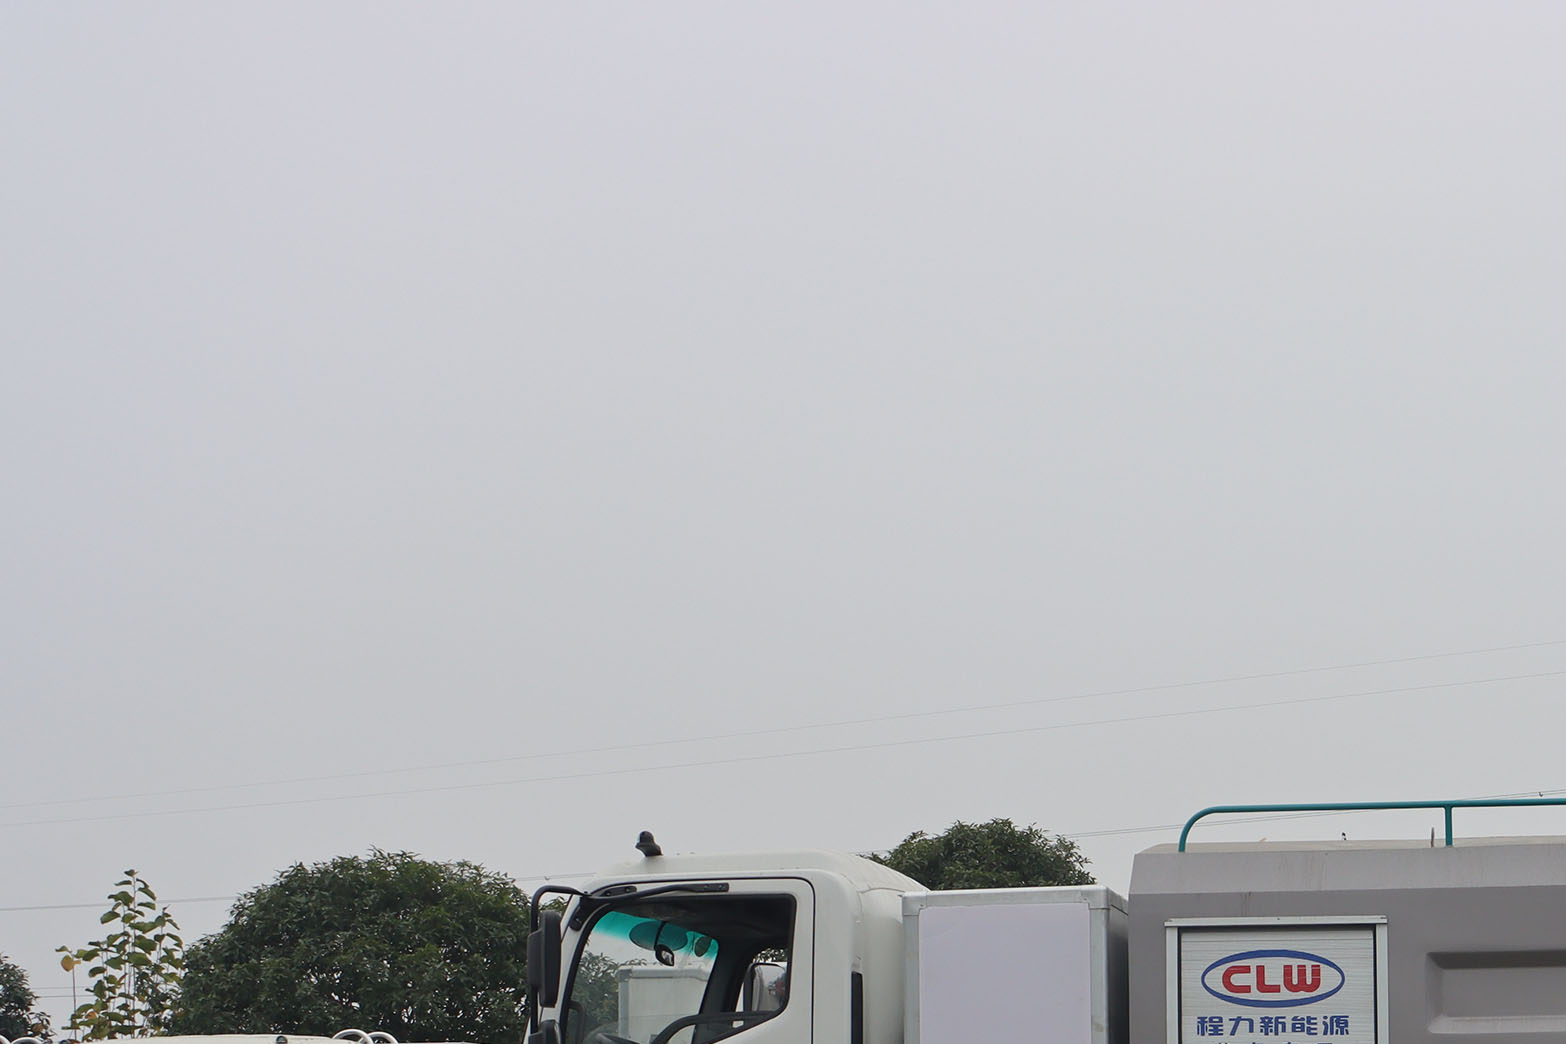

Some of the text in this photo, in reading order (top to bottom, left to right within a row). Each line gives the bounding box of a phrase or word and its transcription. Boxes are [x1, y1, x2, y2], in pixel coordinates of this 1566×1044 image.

[1222, 965, 1321, 993] CLW
[1197, 1016, 1350, 1036] 程力新能源
